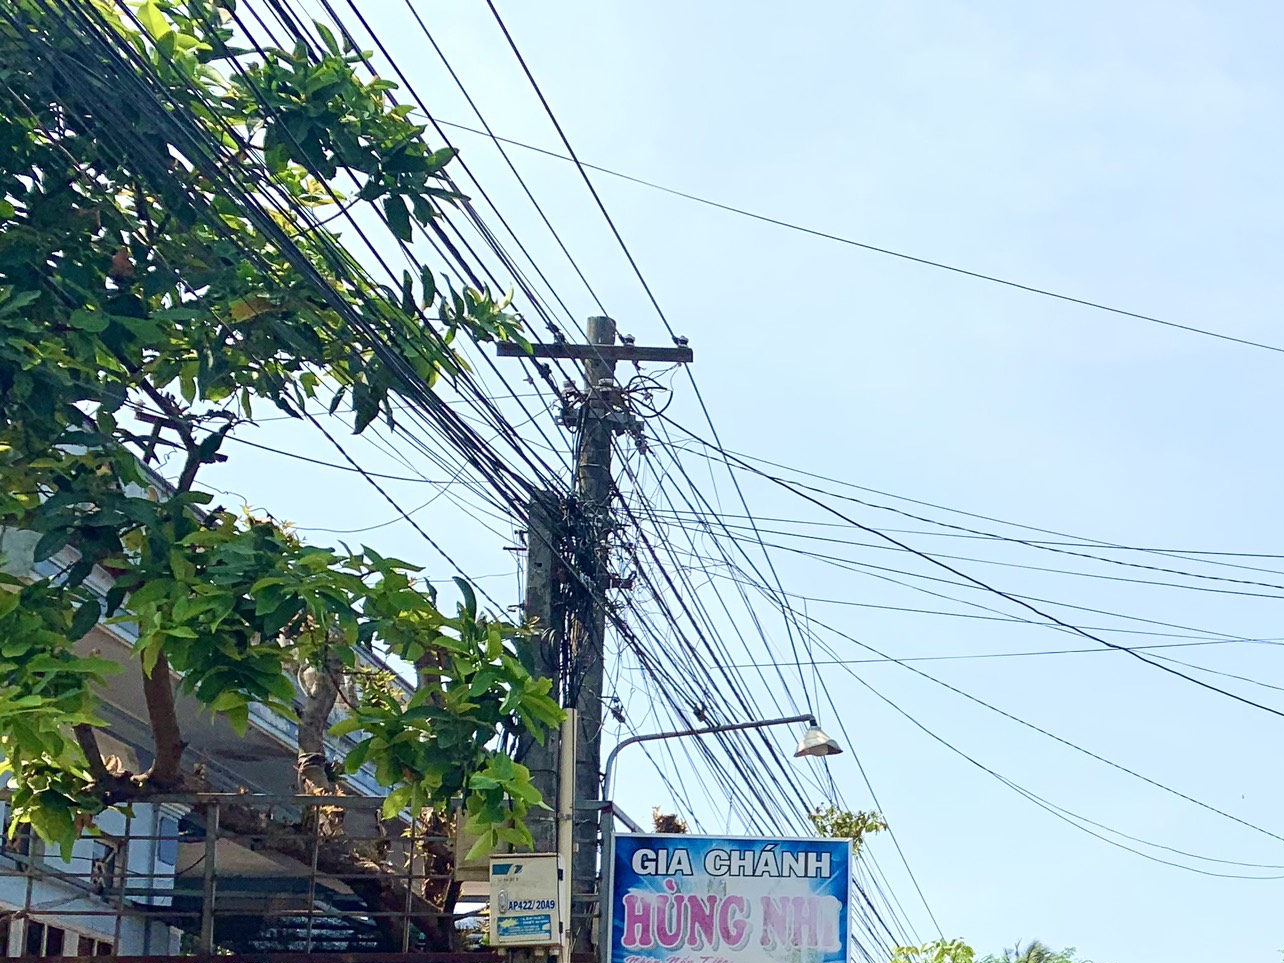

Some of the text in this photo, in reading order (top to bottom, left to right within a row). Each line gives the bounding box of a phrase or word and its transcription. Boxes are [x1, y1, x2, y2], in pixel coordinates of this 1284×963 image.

[632, 844, 832, 878] GIA CHÁNH
[621, 879, 752, 950] HÙNG
